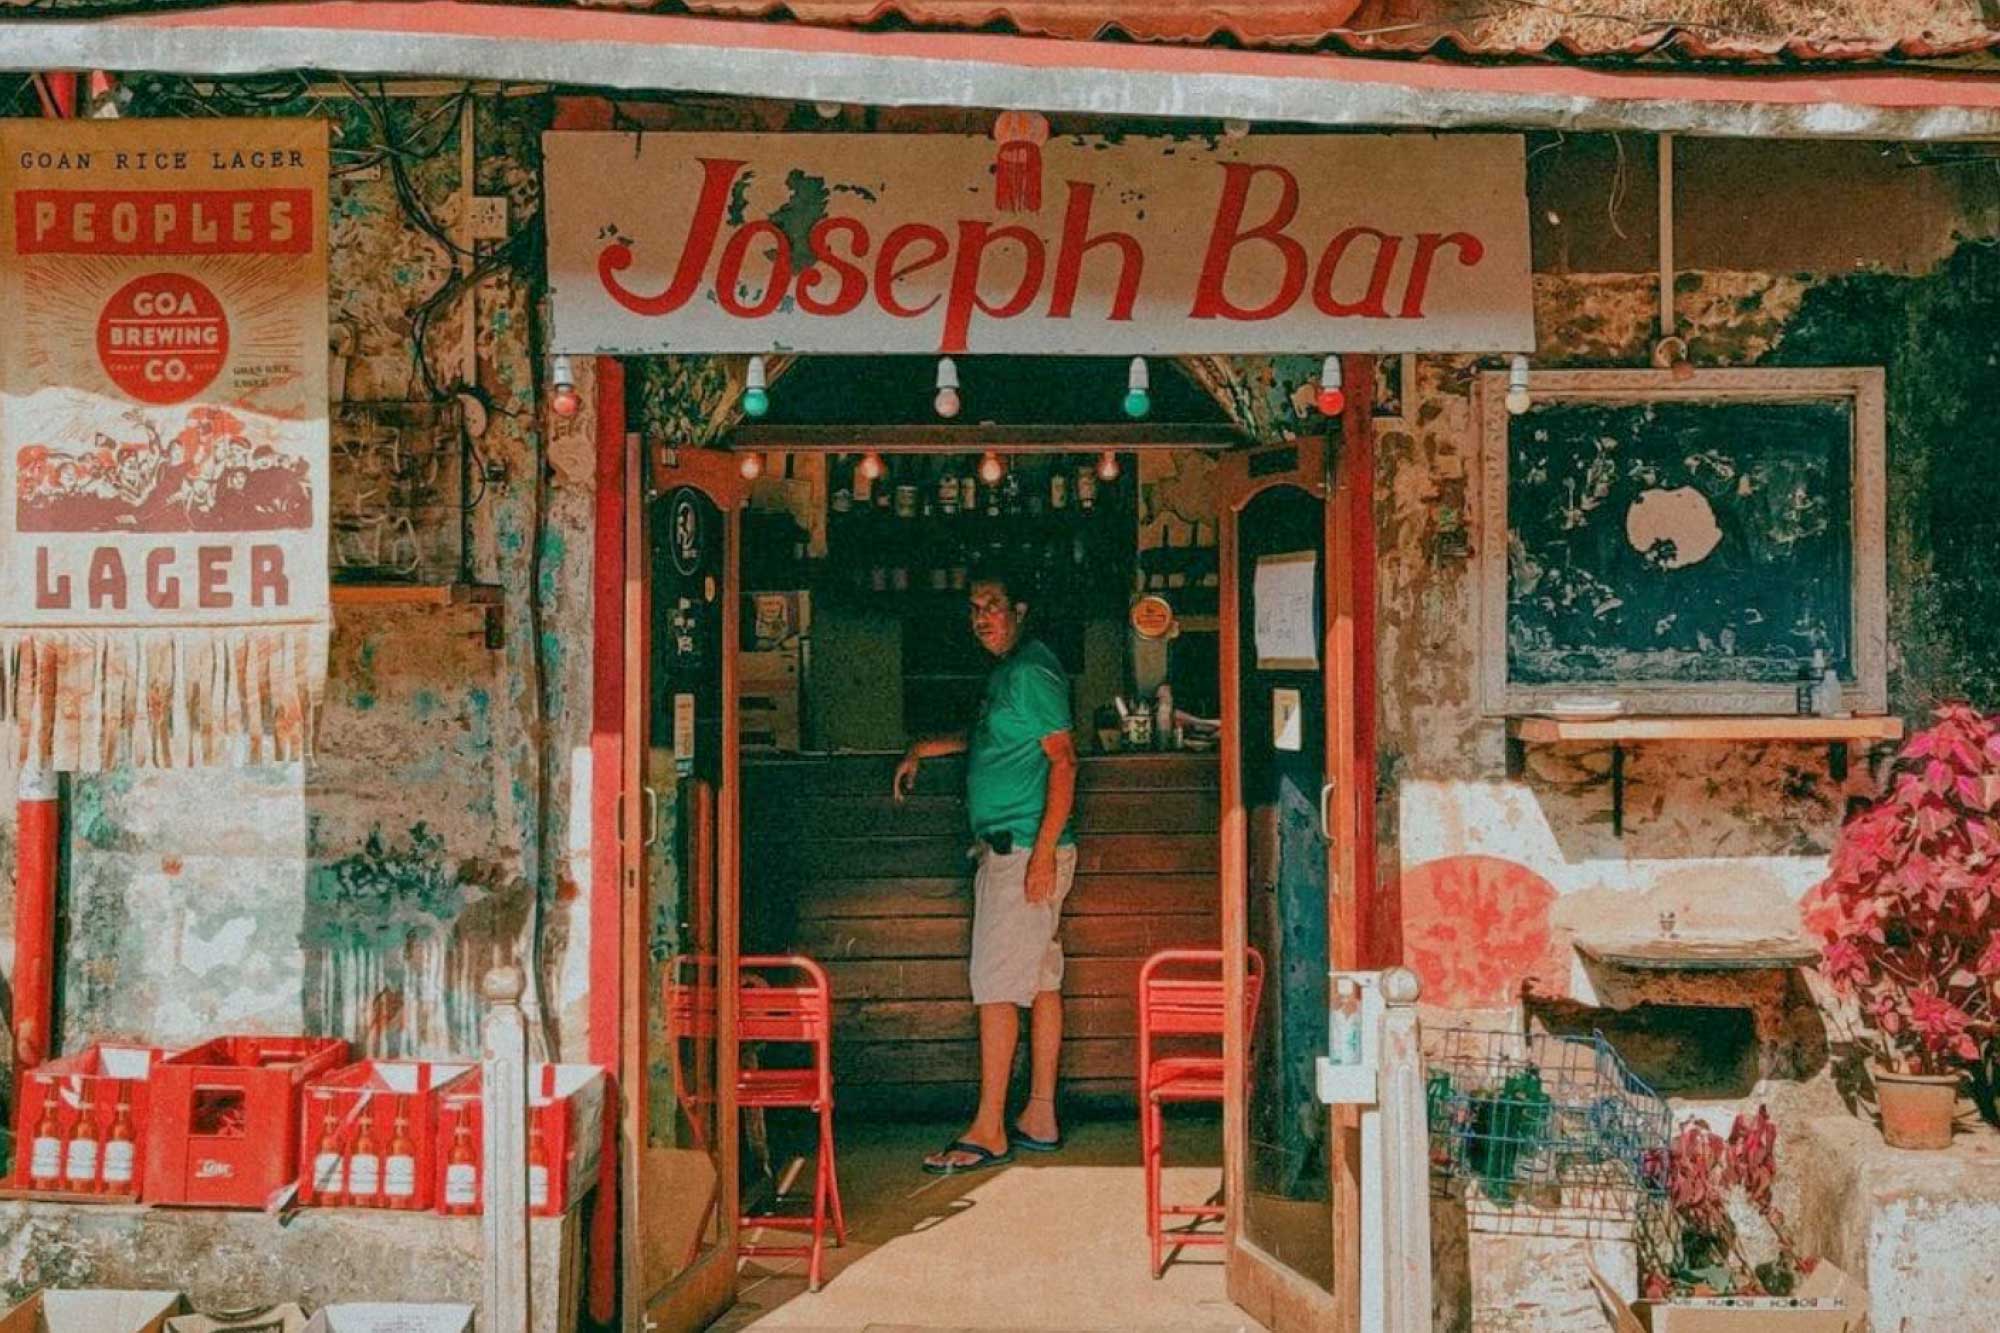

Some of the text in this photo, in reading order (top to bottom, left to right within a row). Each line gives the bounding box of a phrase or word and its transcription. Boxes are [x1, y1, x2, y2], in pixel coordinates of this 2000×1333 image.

[20, 151, 305, 170] GOAN RICE LAGER
[35, 201, 294, 244] PEOPLES
[599, 157, 1484, 354] Joseph Bar
[133, 292, 197, 315] GOA
[109, 326, 219, 346] BREWING
[144, 358, 193, 382] CO.
[35, 544, 289, 610] LAGER
